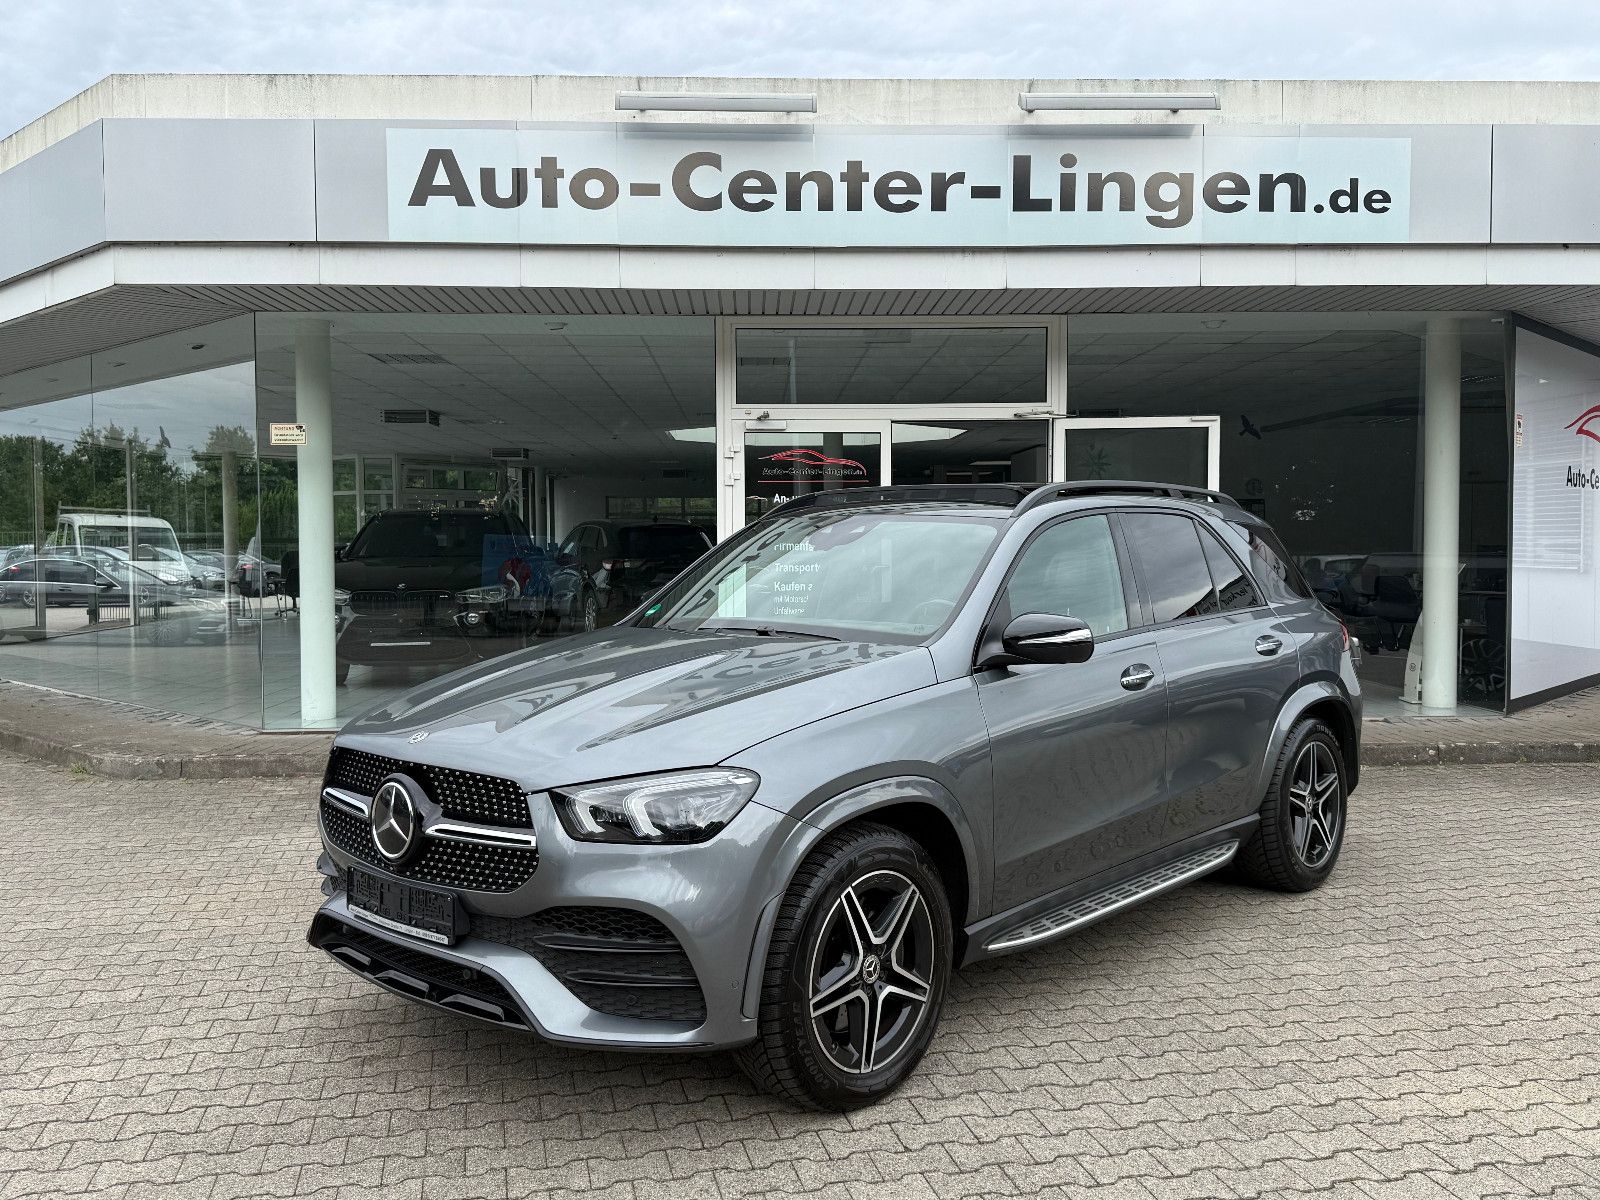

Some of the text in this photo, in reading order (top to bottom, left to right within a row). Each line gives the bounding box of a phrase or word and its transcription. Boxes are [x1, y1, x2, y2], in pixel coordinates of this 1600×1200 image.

[407, 148, 1392, 229] Auto-Center-Lingen.de
[774, 562, 820, 574] Transport
[774, 581, 806, 591] Kaufen
